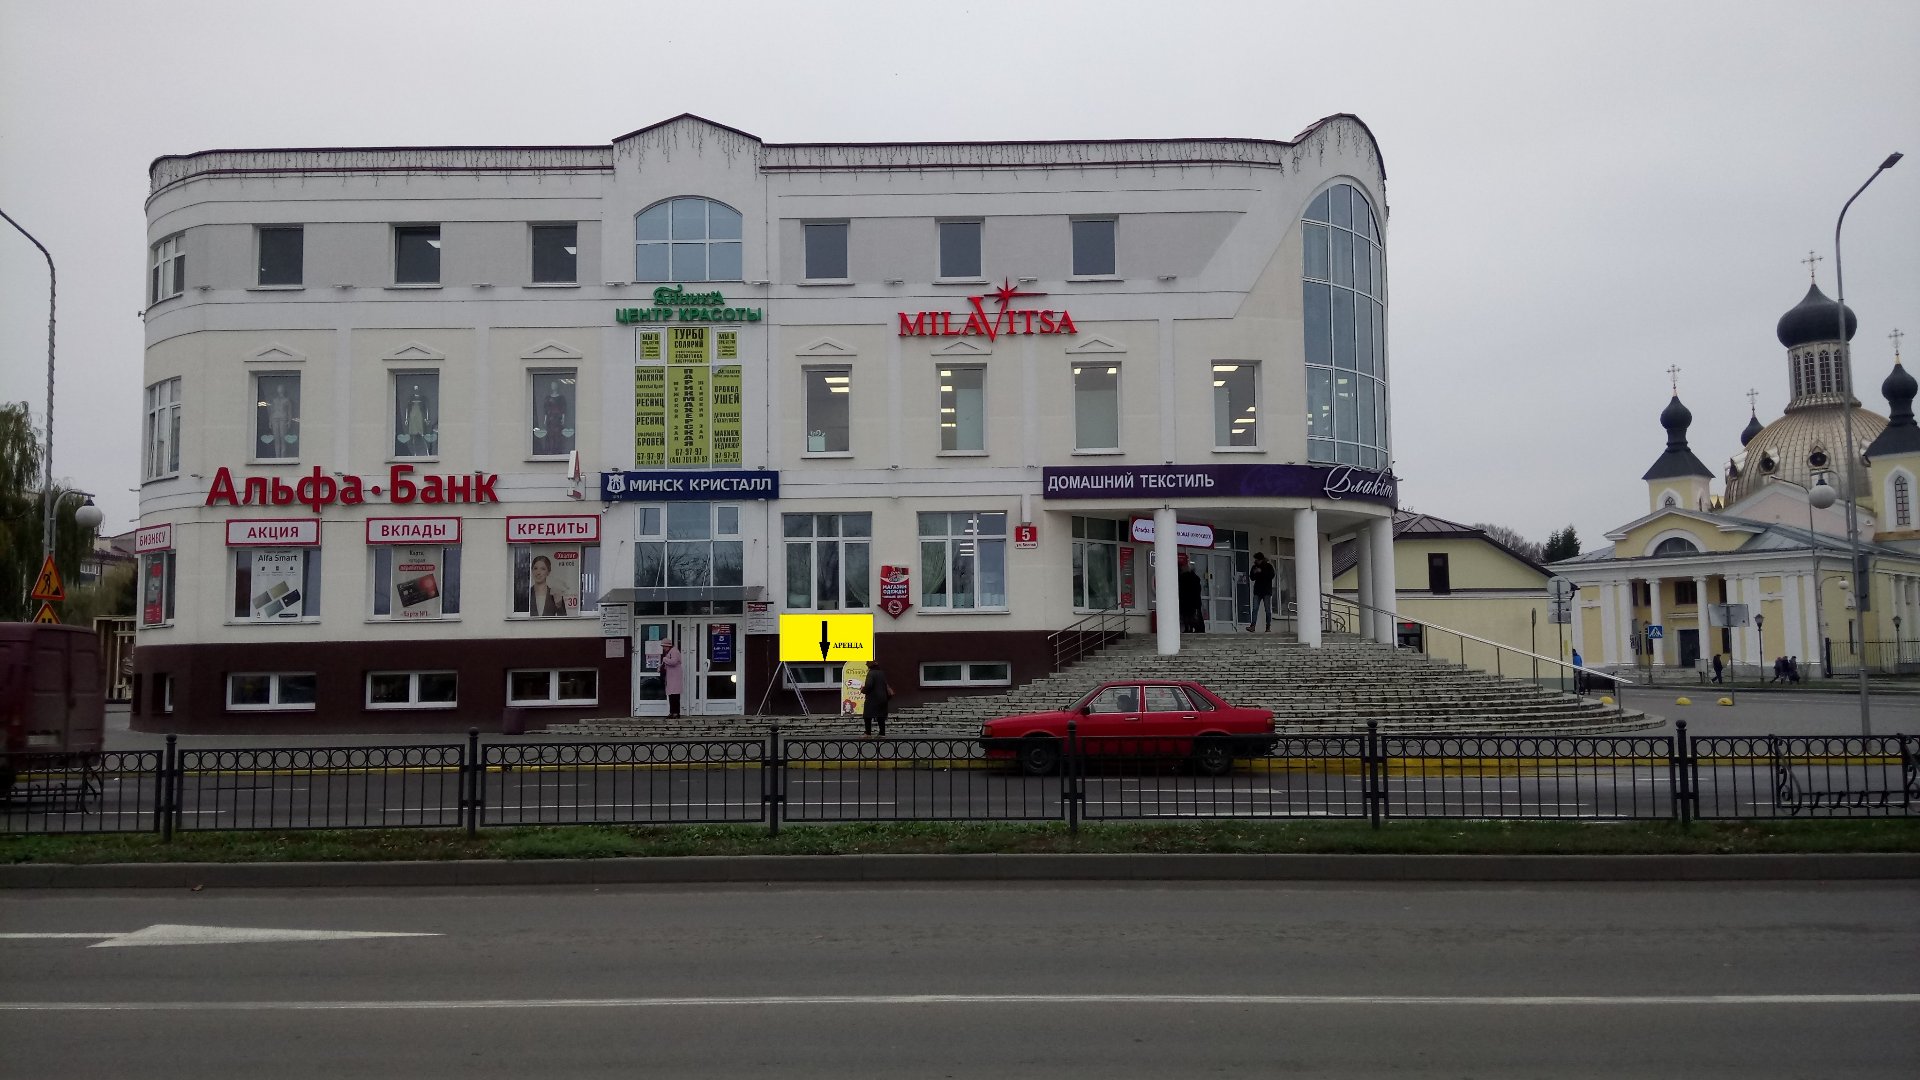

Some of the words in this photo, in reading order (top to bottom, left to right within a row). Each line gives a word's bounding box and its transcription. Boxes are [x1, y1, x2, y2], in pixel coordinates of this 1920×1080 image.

[616, 308, 673, 324] ЦЕНТР
[678, 307, 762, 322] КРАСОТЫ
[898, 296, 1077, 343] MILAVITSA
[673, 328, 704, 339] ТУРБО
[674, 340, 704, 349] СОЛЯРИЙ
[636, 373, 664, 382] МАКИЯЖ
[636, 398, 665, 408] РЕСНИЦ
[714, 393, 740, 404] УШЕЙ
[636, 416, 665, 426] РЕСНИЦ
[637, 437, 665, 447] БРОВЕЙ
[629, 479, 684, 492] МИНСК
[689, 478, 772, 491] КРИСТАЛЛ
[1047, 472, 1134, 491] ДОМАШНИЙ
[1140, 473, 1215, 488] ТЕКСТИЛЬ
[247, 526, 299, 541] АКЦИЯ
[381, 524, 446, 538] ВКЛАДЫ
[517, 522, 588, 536] КРЕДИТЫ
[1022, 528, 1031, 541] 5
[139, 531, 166, 546] БИЗНЕСУ
[258, 554, 273, 562] Alfa
[275, 554, 298, 562] Smart
[567, 597, 578, 607] 30
